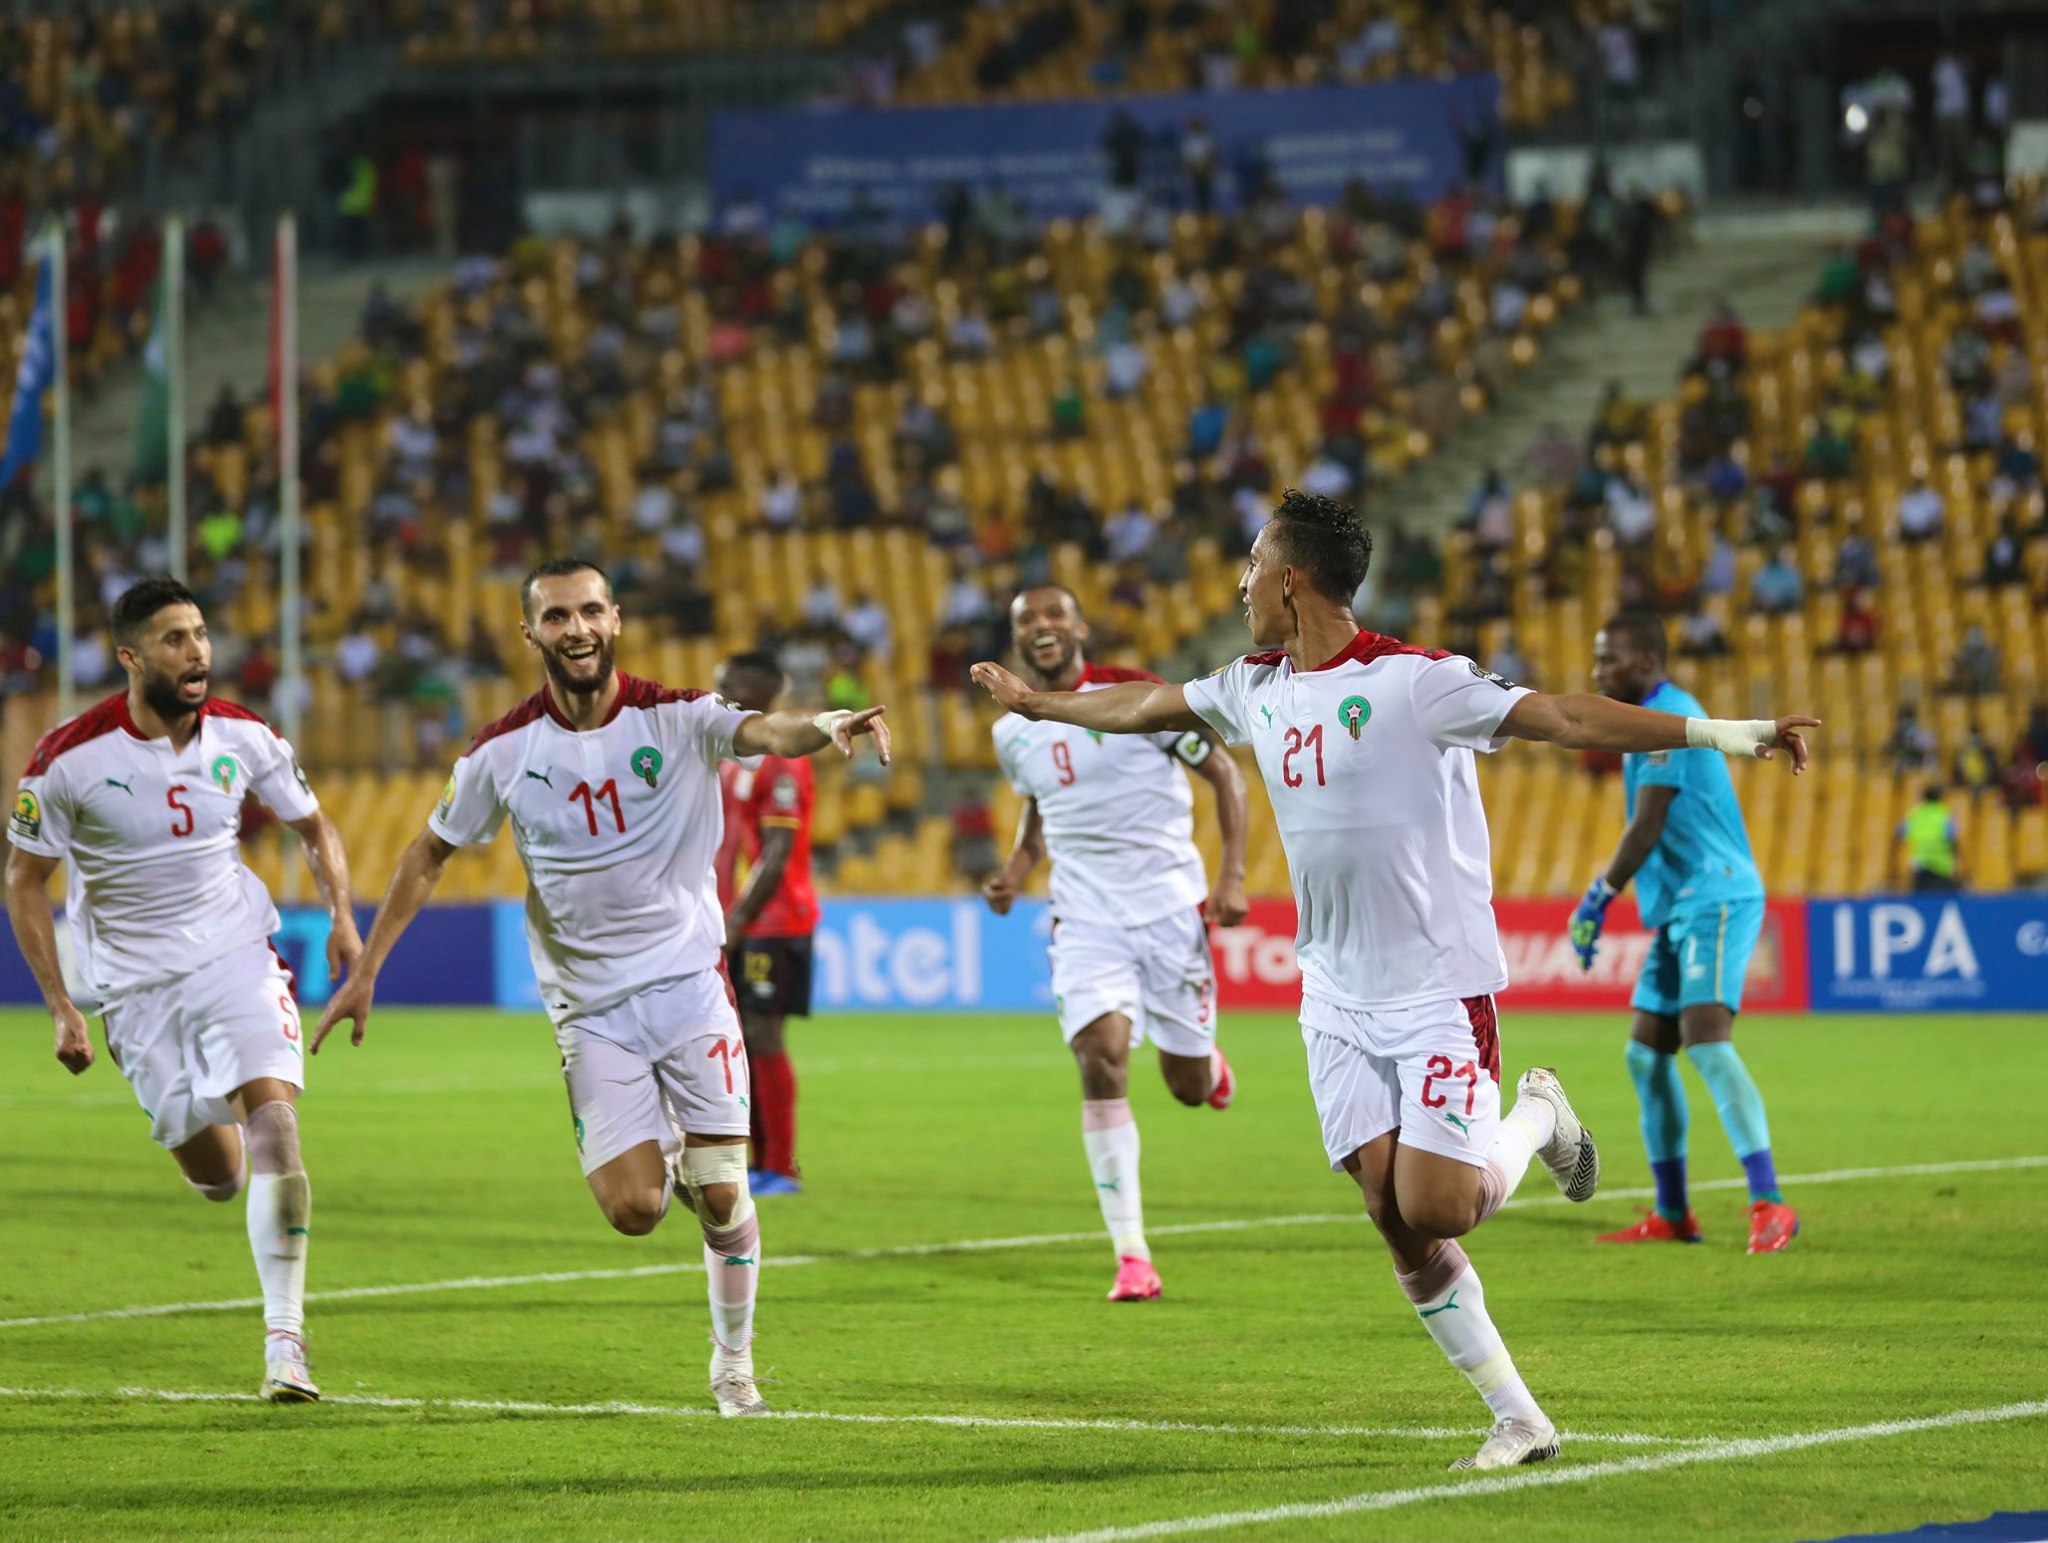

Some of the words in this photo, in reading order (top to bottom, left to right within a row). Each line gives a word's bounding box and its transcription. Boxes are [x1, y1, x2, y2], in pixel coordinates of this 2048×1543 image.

[1052, 741, 1076, 787] 9
[1283, 723, 1326, 788] 21
[166, 785, 194, 838] 5
[568, 778, 626, 836] 11
[1833, 899, 1981, 979] IPA
[1421, 1055, 1478, 1116] 21
